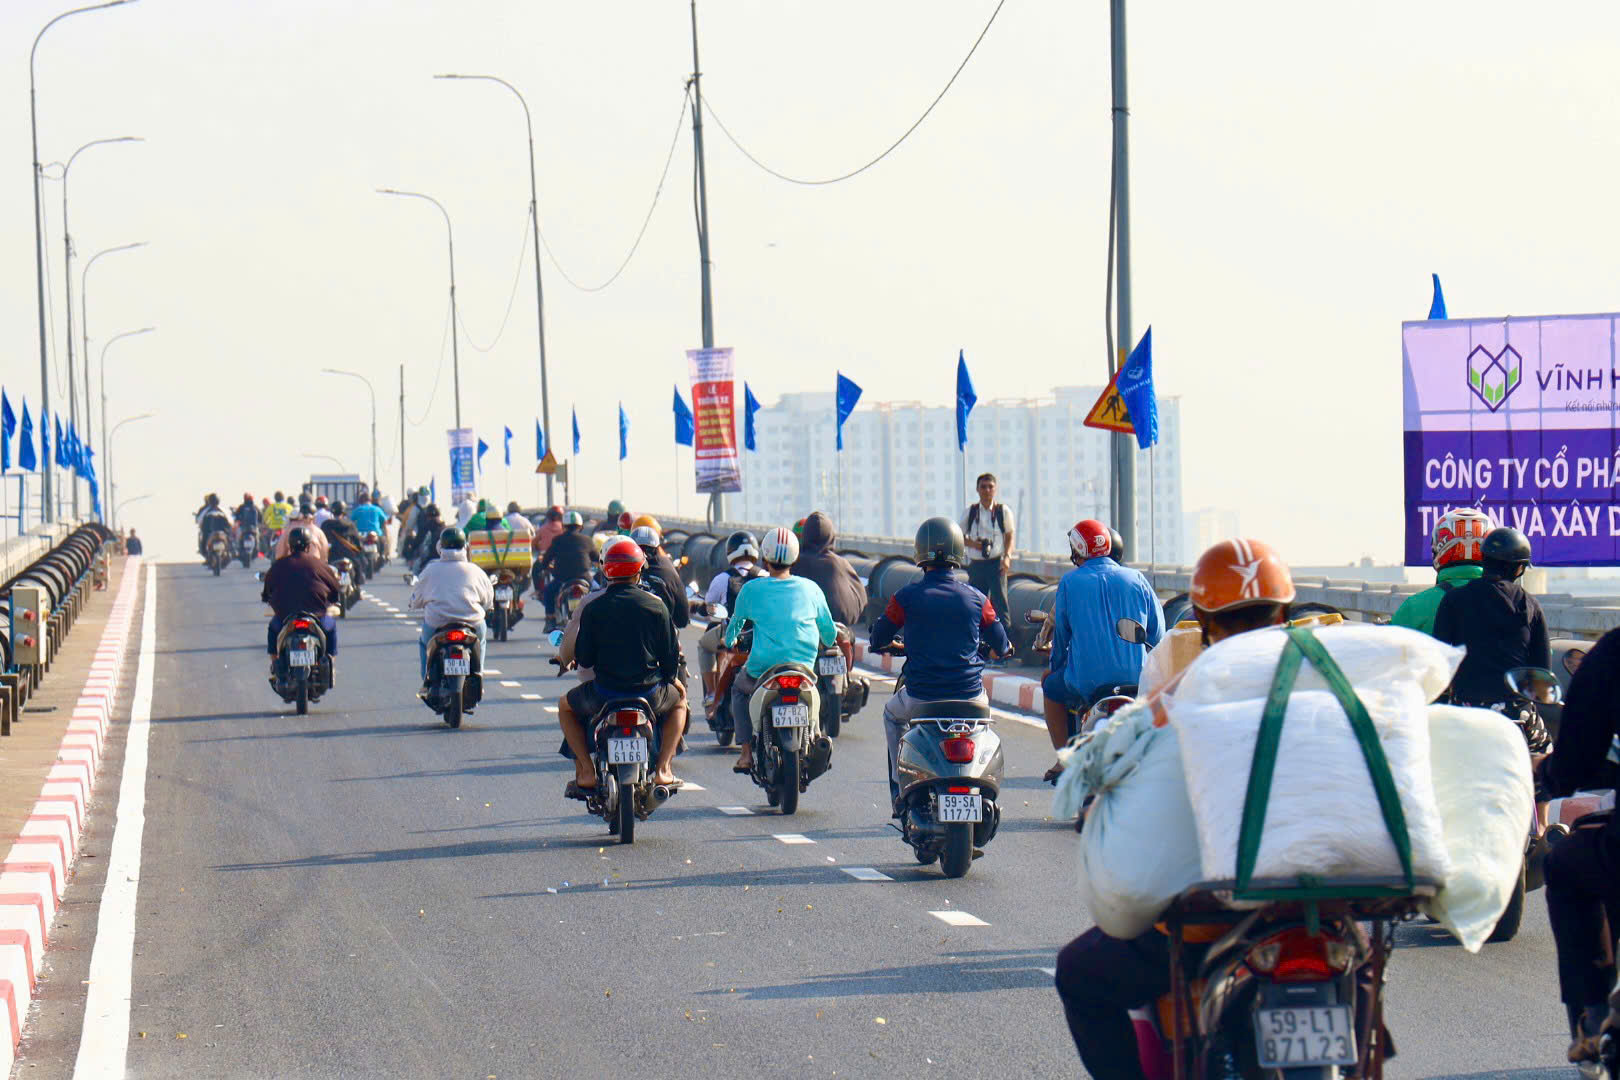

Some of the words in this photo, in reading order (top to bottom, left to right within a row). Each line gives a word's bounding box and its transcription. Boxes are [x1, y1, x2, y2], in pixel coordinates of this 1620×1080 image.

[1535, 363, 1603, 391] VĨNH
[1425, 452, 1492, 488] CÔNG
[1498, 458, 1529, 488] TY
[1534, 445, 1569, 488] CỔ
[1512, 498, 1547, 537] VÀ
[1551, 498, 1601, 537] XÂY
[613, 740, 640, 751] 71-K1
[614, 751, 641, 762] 6166
[944, 796, 975, 808] 59-SA
[1269, 1009, 1335, 1034] 59-L1
